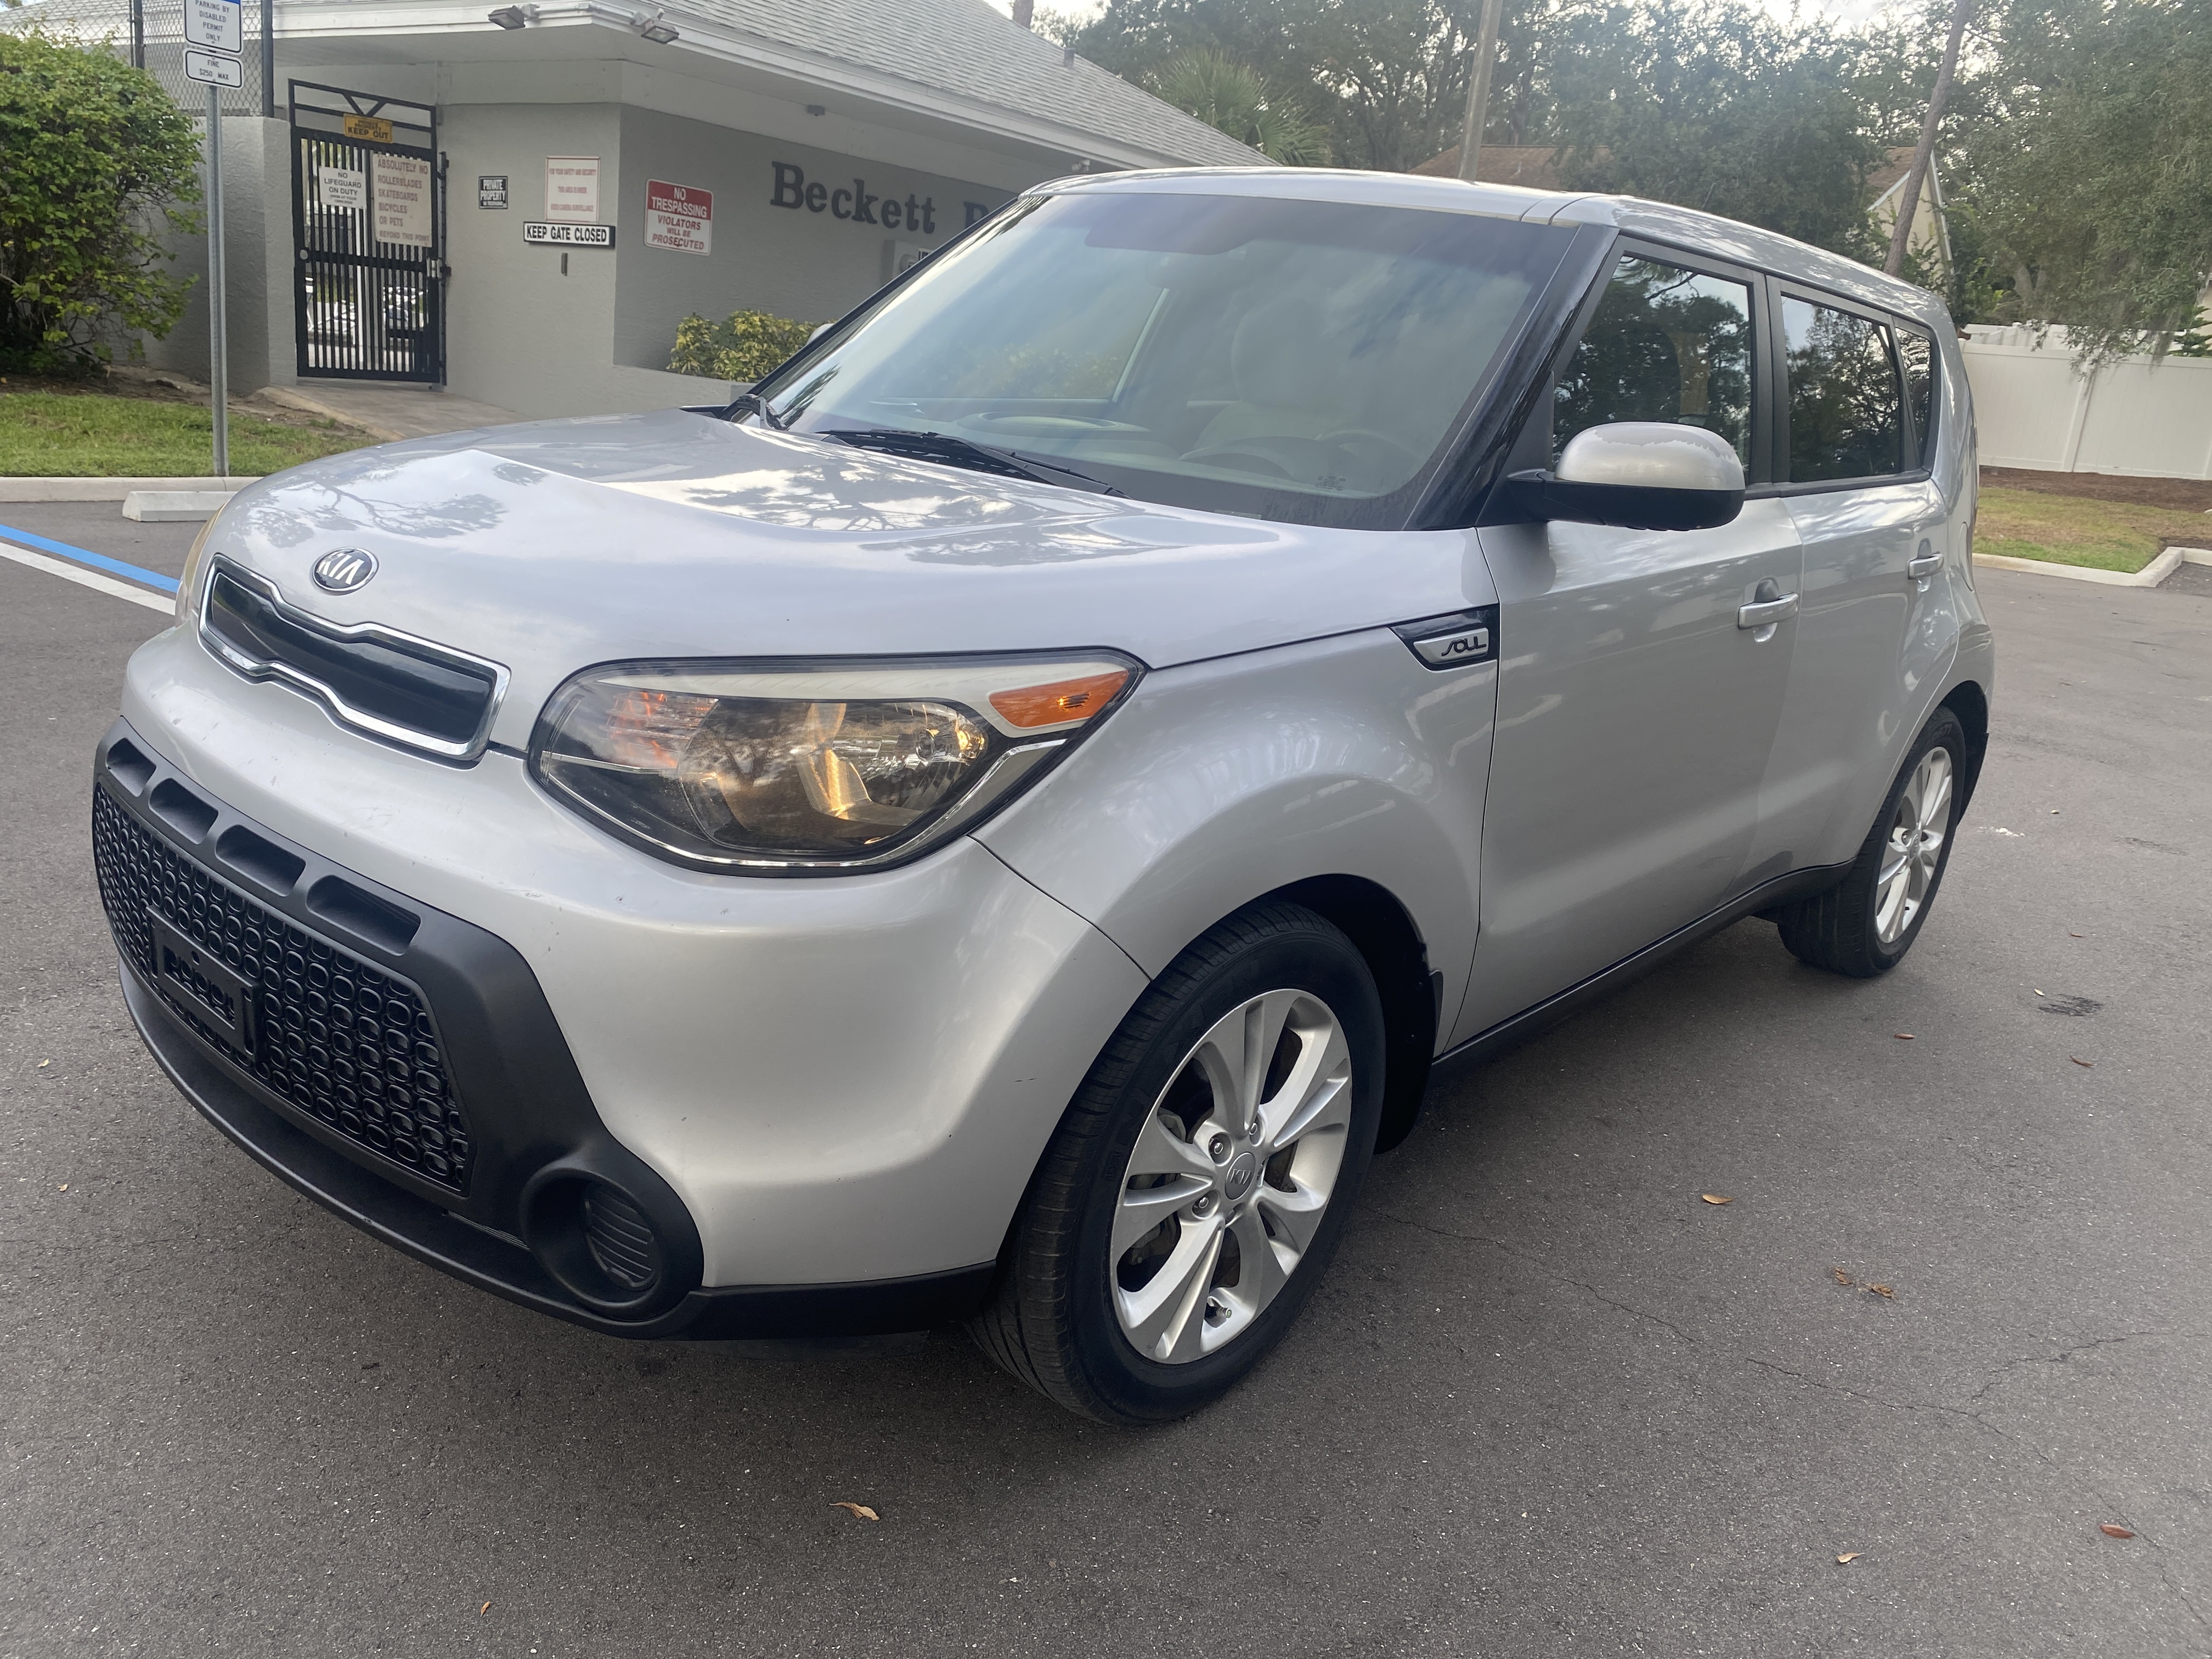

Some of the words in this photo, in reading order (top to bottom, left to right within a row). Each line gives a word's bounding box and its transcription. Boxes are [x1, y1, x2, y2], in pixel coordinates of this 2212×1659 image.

[195, 0, 219, 10] PARKING
[199, 10, 226, 22] DISABLED
[203, 22, 223, 32] PERMIT
[206, 33, 220, 41] ONLY
[207, 59, 219, 67] FINE
[199, 68, 213, 77] $250
[348, 126, 369, 136] KEEP
[374, 130, 388, 139] OUT
[377, 159, 416, 173] ABSOLUTELY
[419, 165, 428, 174] NO
[324, 178, 362, 188] LIFEGUARD
[377, 175, 422, 189] ROLLERBLADES
[483, 179, 503, 190] PRIVATE
[378, 188, 417, 202] SKATEBOARDS
[481, 190, 506, 201] PROPERTY
[674, 187, 686, 200] NO
[770, 160, 936, 234] Beckett
[379, 202, 407, 213] BICYCLES
[651, 196, 707, 218] TRESPASSING
[379, 216, 387, 224] OR
[390, 217, 403, 227] PETS
[658, 215, 701, 230] VIOLATORS
[527, 225, 547, 239] KEEP
[551, 226, 571, 240] GATE
[575, 227, 607, 242] CLOSED
[667, 227, 681, 236] WILL
[652, 234, 704, 250] PROSECUTED
[1441, 636, 1487, 657] SOUL
